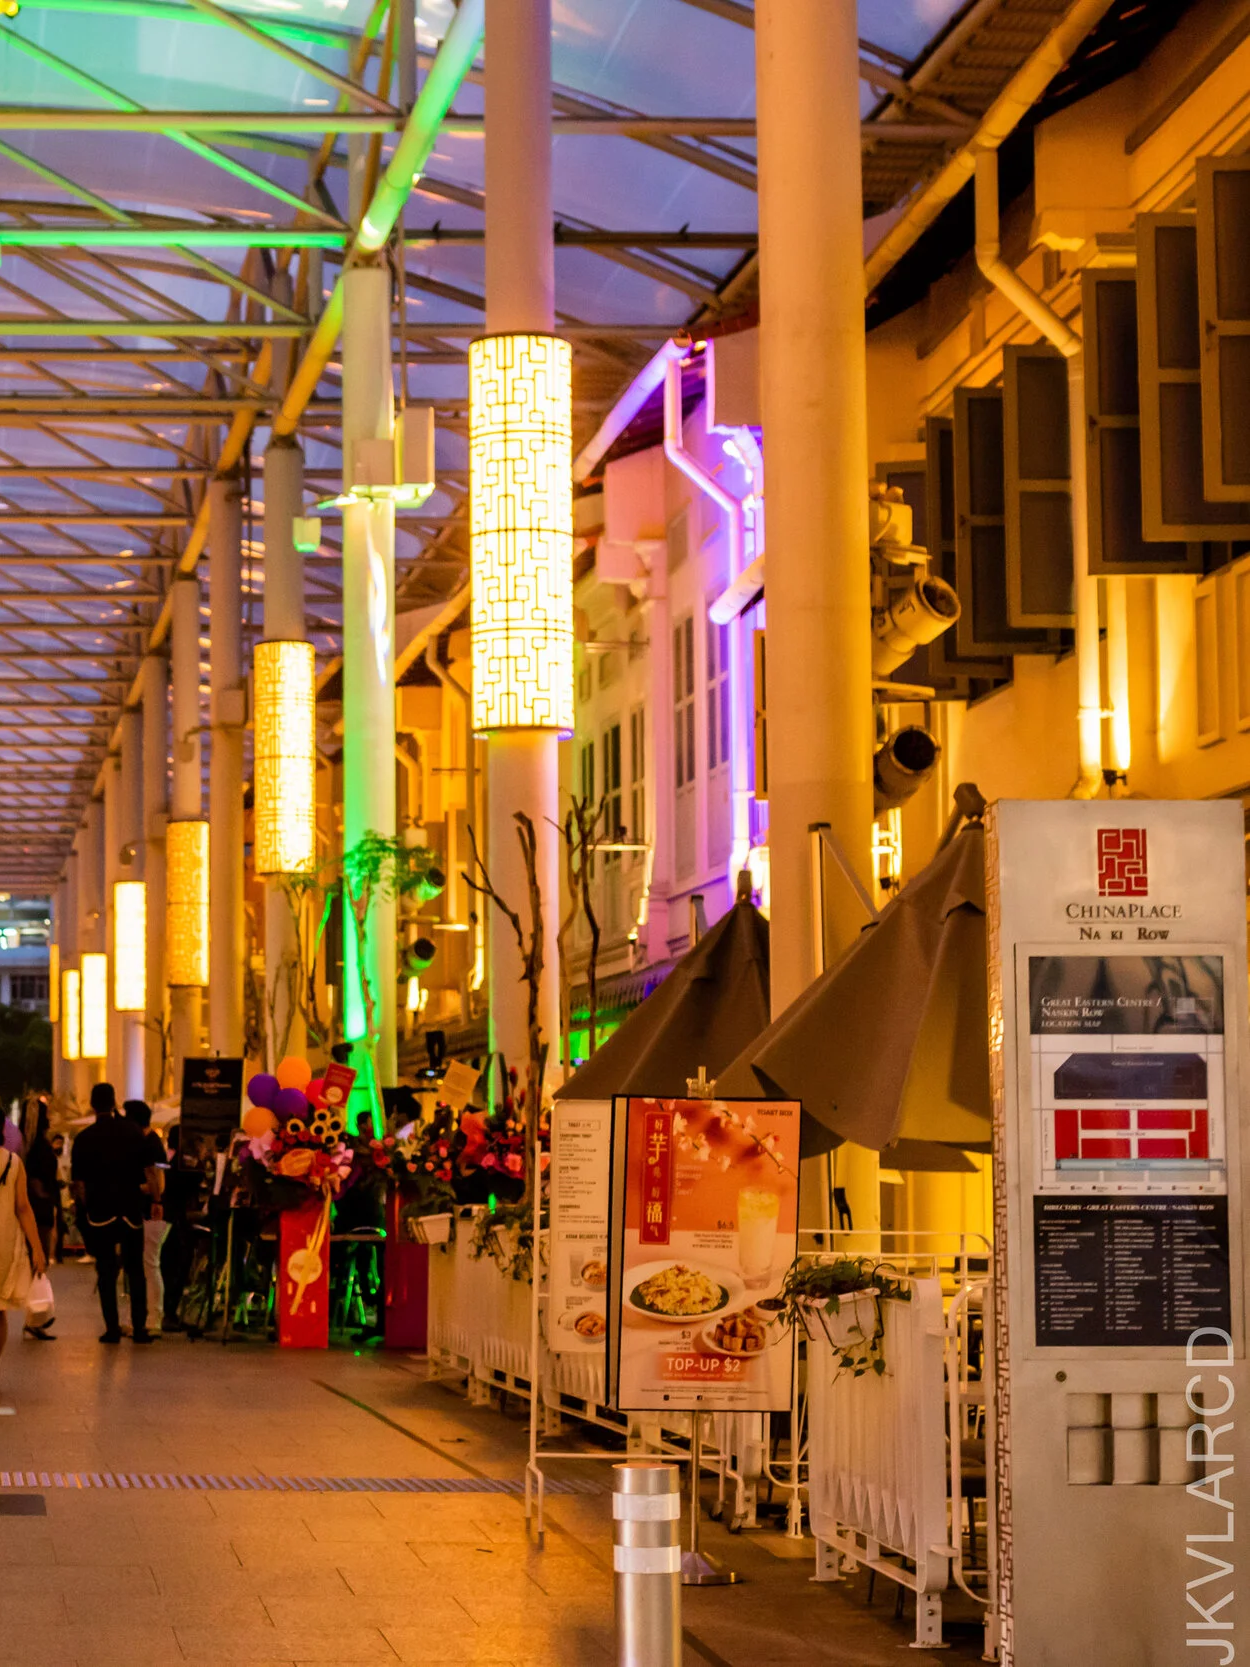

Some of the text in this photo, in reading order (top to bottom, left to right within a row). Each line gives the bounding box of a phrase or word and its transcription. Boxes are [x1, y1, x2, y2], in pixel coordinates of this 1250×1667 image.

[1065, 903, 1182, 919] CHINAPLACE
[1137, 926, 1170, 940] ROW
[1041, 997, 1071, 1007] GREAT
[1074, 997, 1114, 1007] EASTERN
[1082, 1008, 1104, 1017] ROW
[666, 1356, 742, 1373] TOP-UP $2
